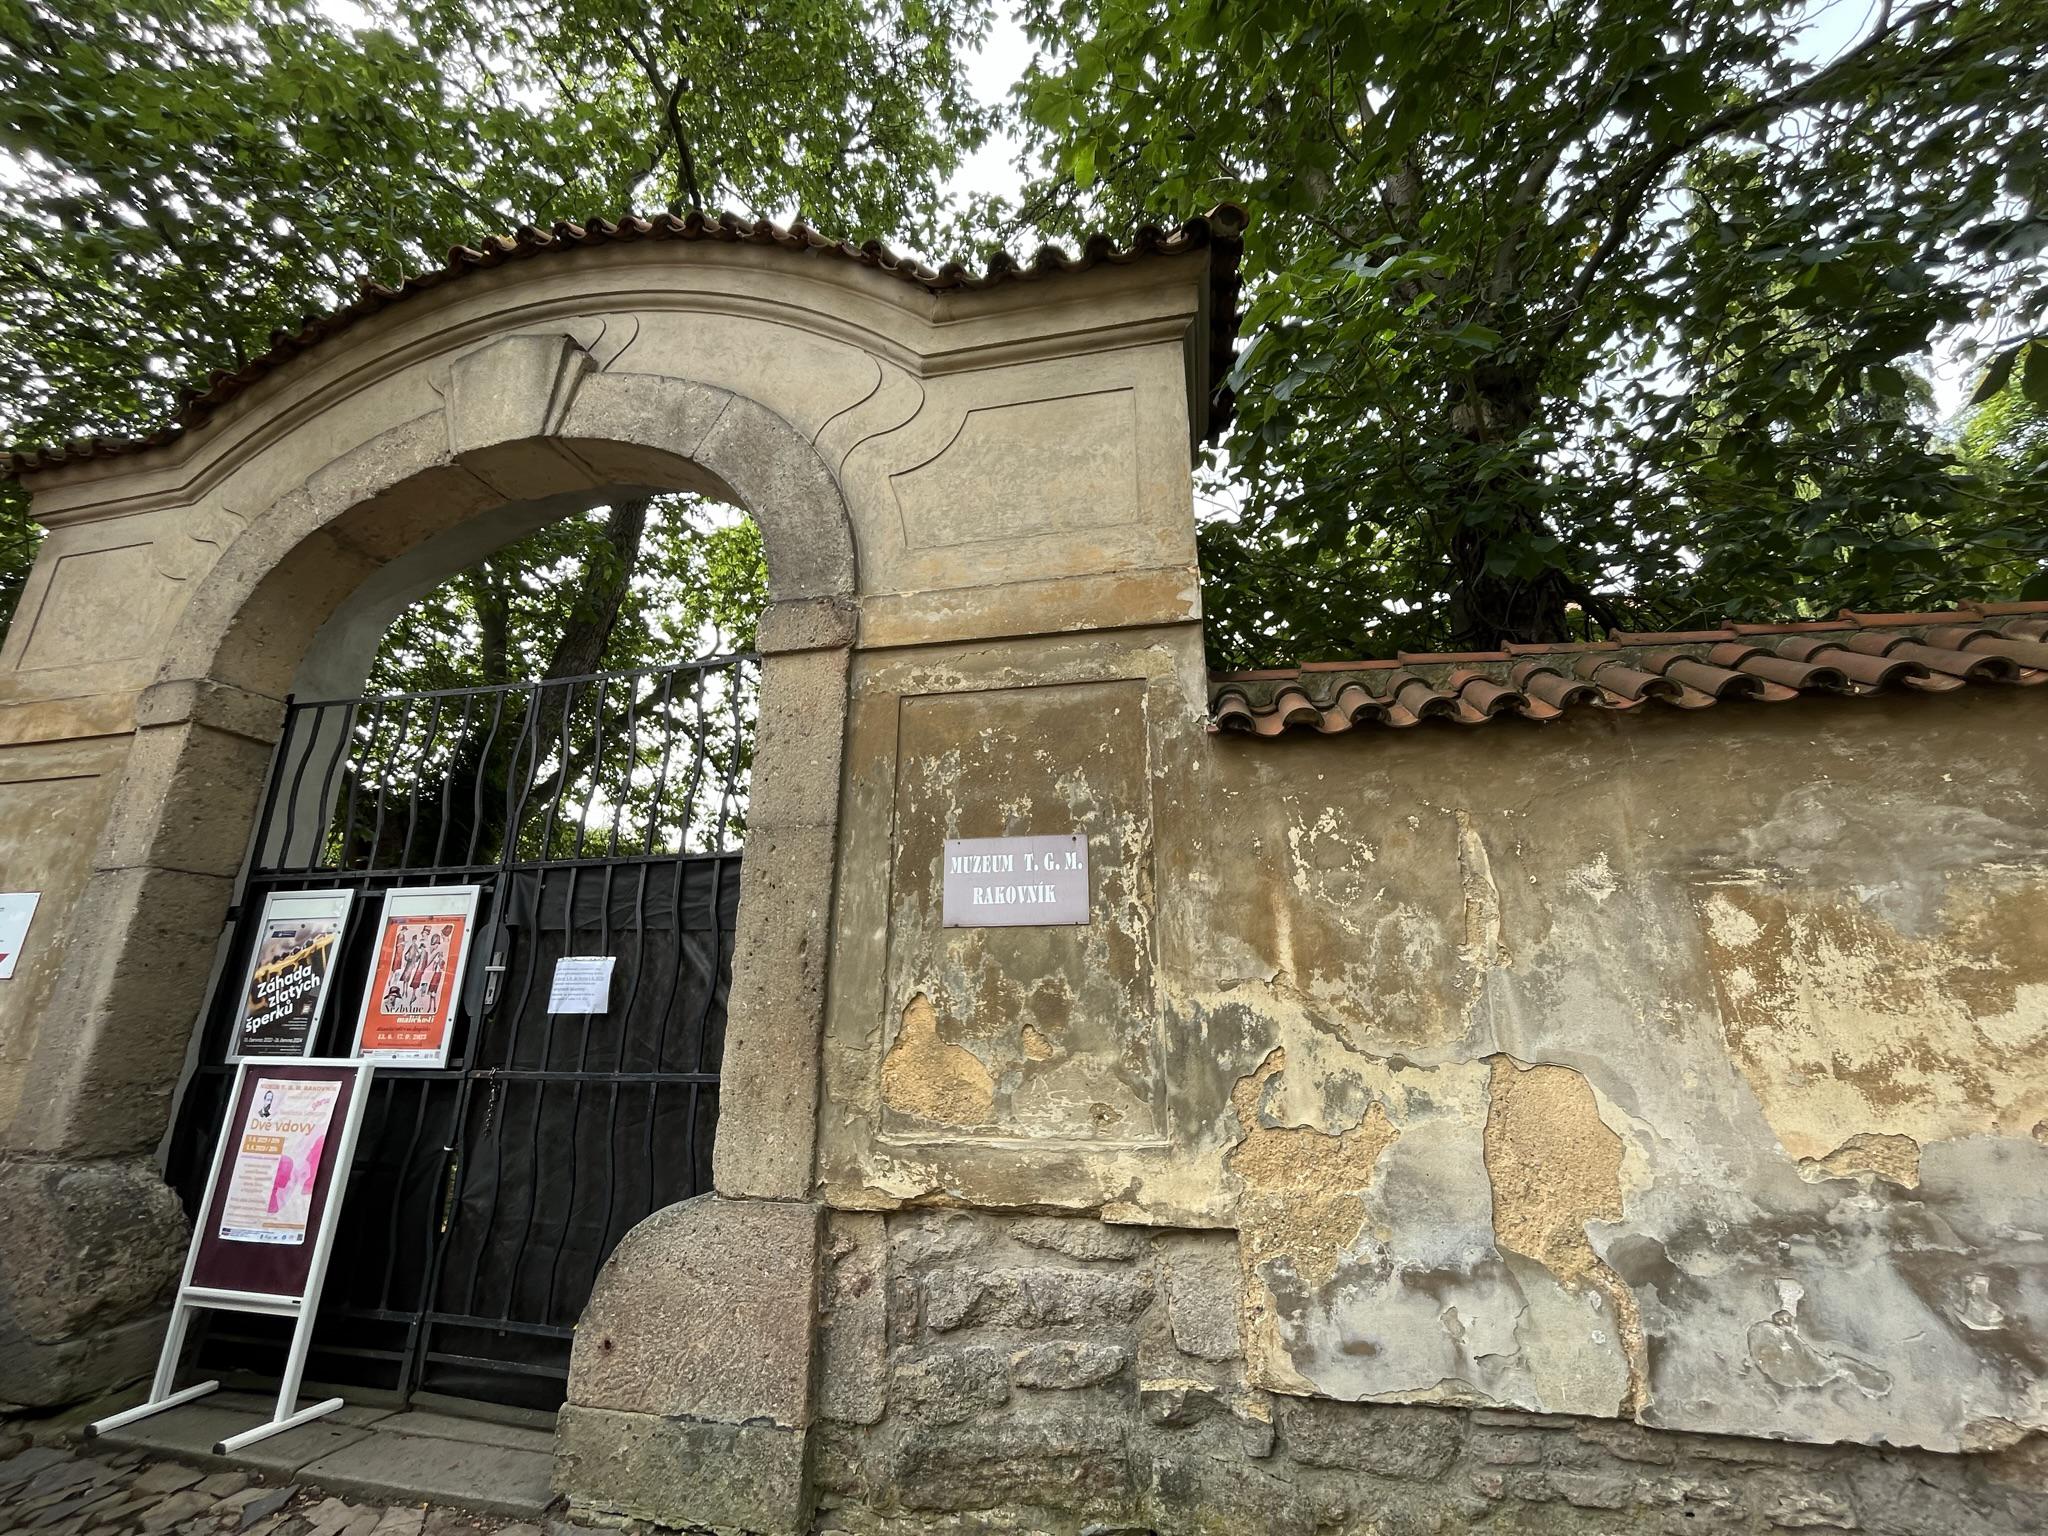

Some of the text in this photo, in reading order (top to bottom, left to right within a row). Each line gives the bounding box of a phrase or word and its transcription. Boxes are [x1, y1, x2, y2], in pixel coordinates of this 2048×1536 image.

[950, 852, 1083, 874] MUZEUM T. G. M.
[973, 881, 1057, 905] RAKOVNÍK
[257, 965, 312, 998] Záhada
[268, 975, 320, 1008] zlatých
[245, 1000, 294, 1033] šperků
[251, 1117, 316, 1136] Dvě vdovy
